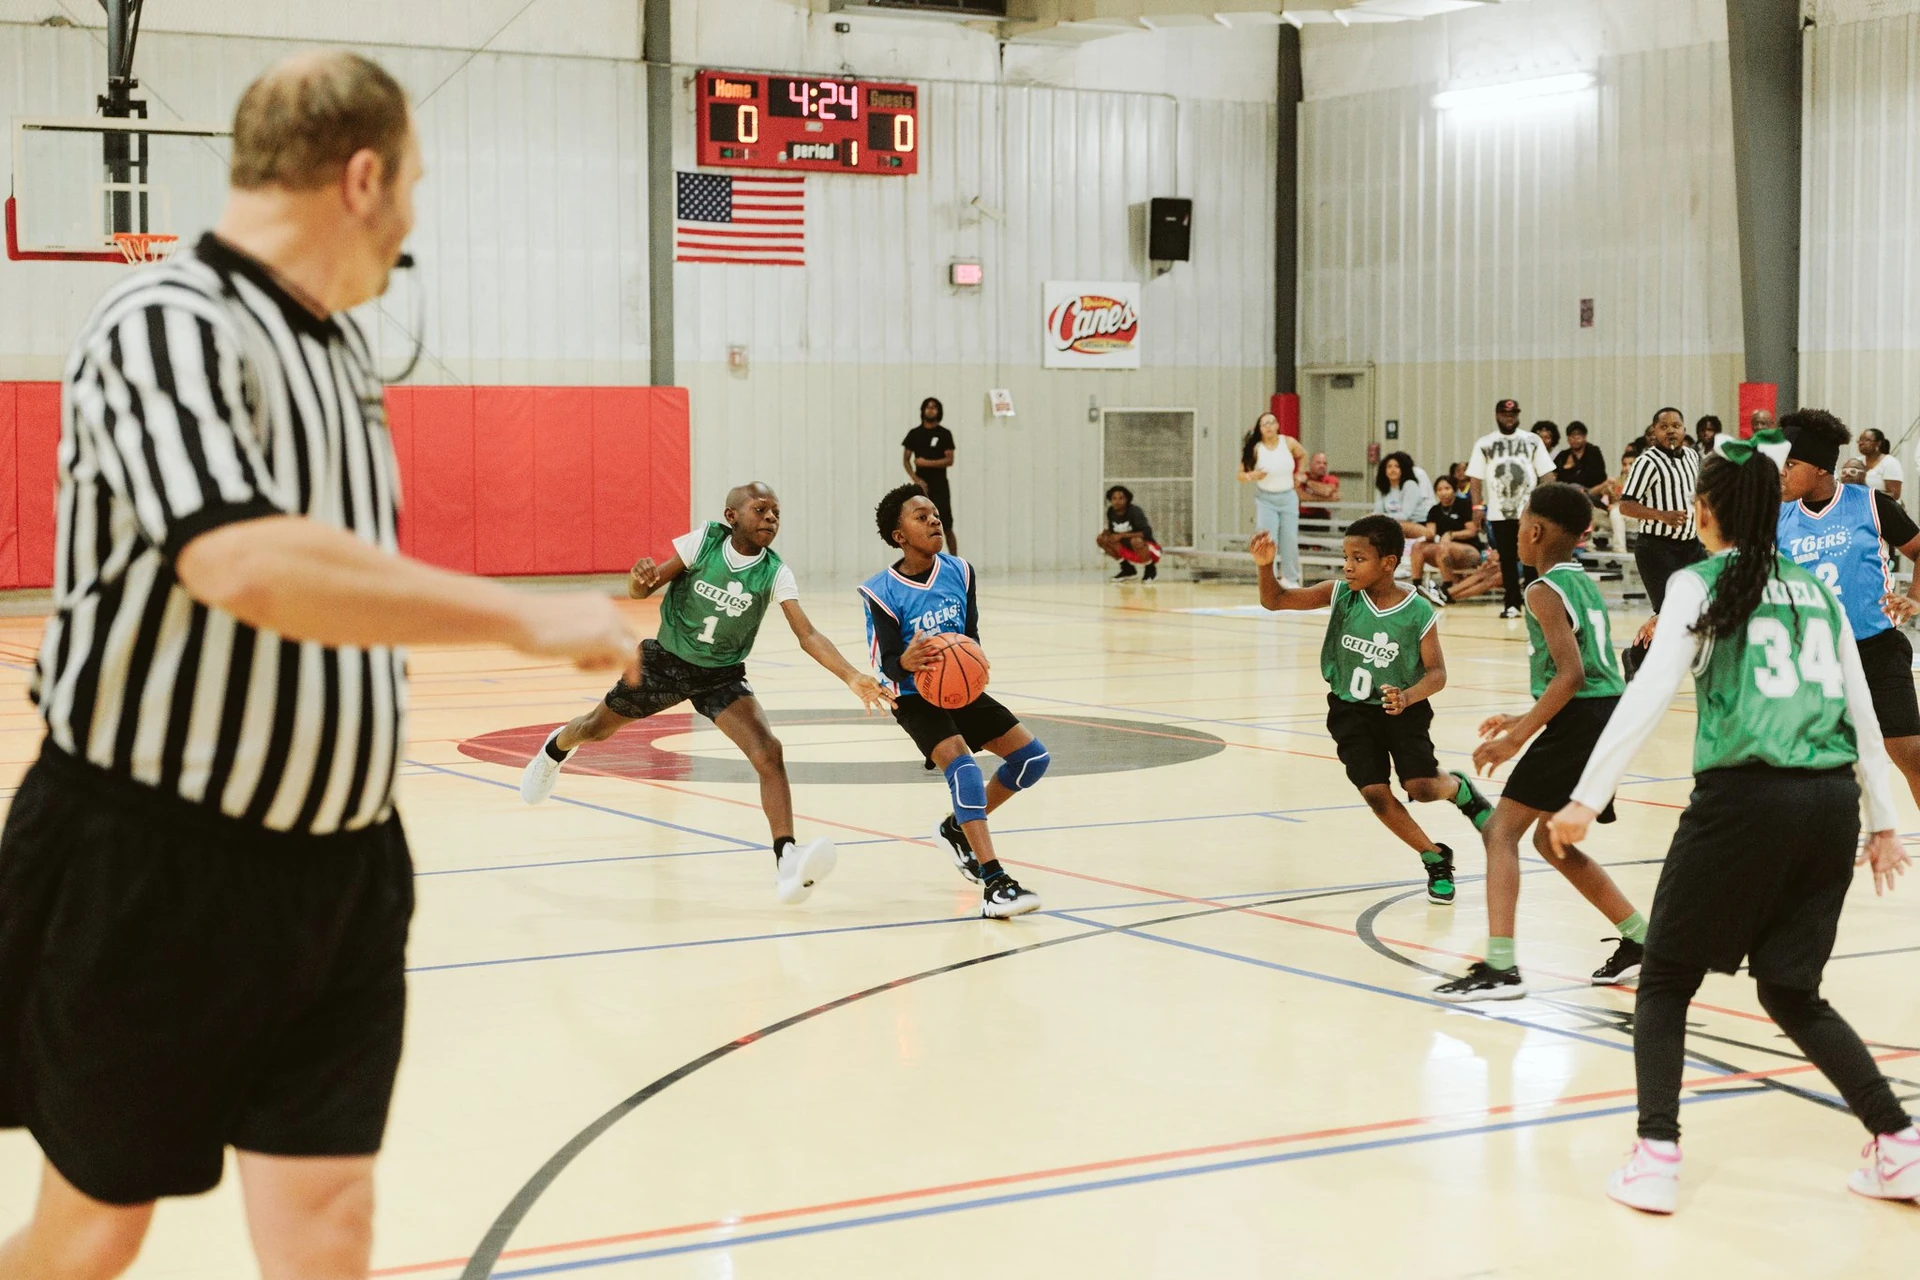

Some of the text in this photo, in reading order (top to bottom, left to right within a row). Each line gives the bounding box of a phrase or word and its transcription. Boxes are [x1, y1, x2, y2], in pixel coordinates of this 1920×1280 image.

[715, 79, 752, 99] Home
[789, 82, 858, 119] 4:24
[738, 105, 758, 143] 0
[894, 115, 914, 152] 0
[793, 143, 835, 160] period
[851, 141, 858, 166] 1
[1790, 531, 1847, 556] 76ERS
[695, 582, 749, 610] CELTICS
[697, 616, 719, 644] 1
[909, 604, 958, 635] 76ERS
[1343, 636, 1395, 660] CELTICS
[1747, 617, 1845, 698] 34
[1350, 667, 1372, 700] 0
